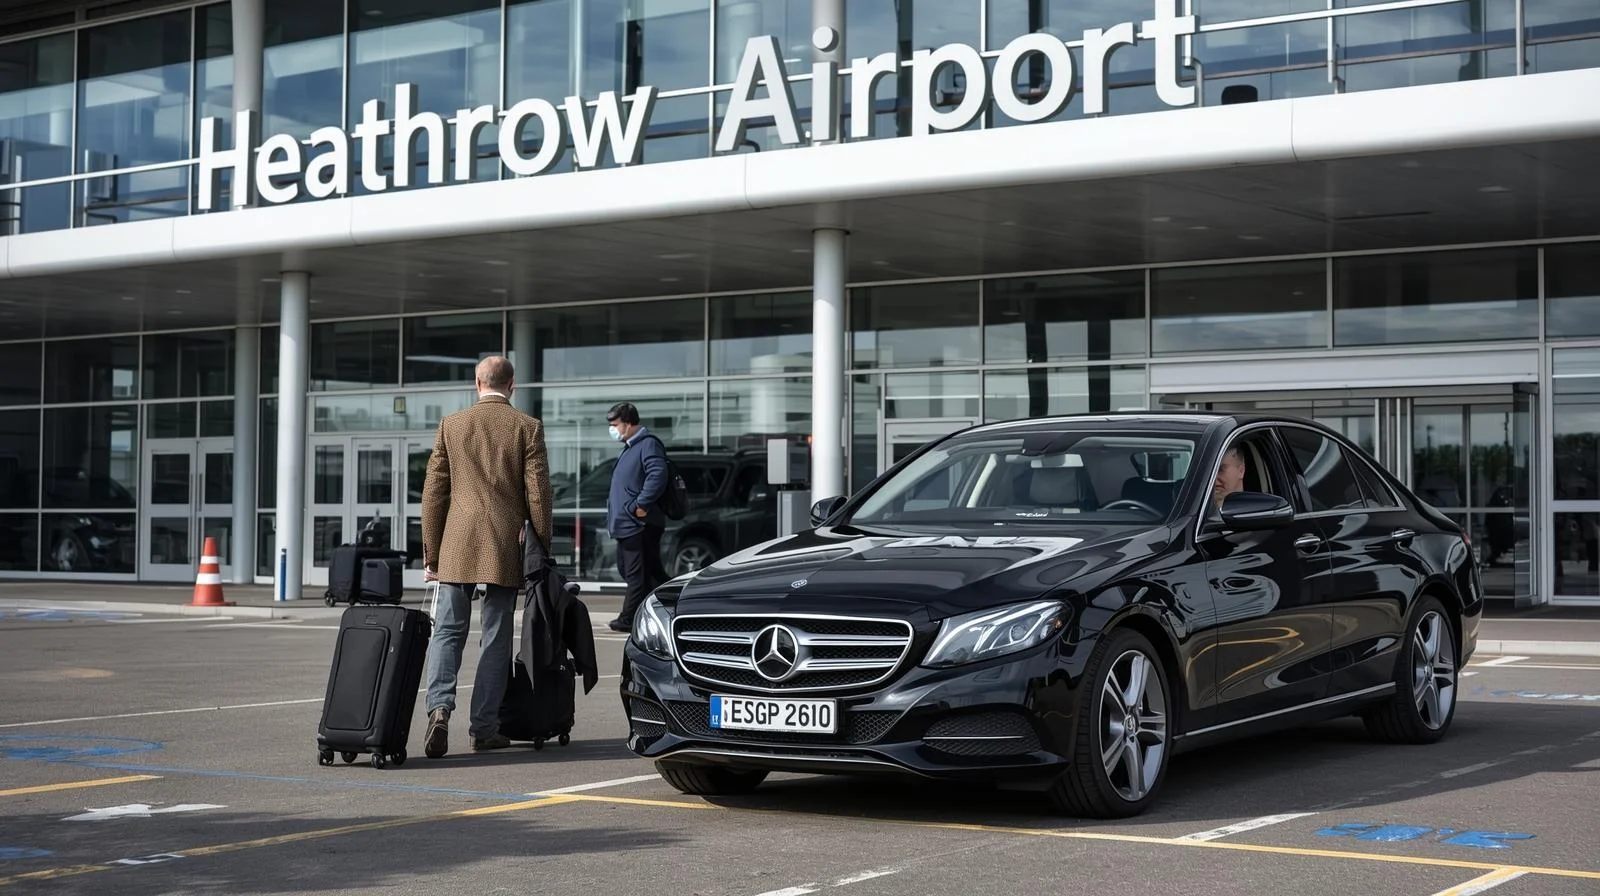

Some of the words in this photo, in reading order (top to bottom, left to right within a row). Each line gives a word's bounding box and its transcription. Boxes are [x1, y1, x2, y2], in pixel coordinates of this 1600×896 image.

[197, 83, 659, 210] Heathrow
[715, 0, 1199, 152] Airport
[731, 700, 780, 725] ESGP
[785, 703, 831, 728] 2610
